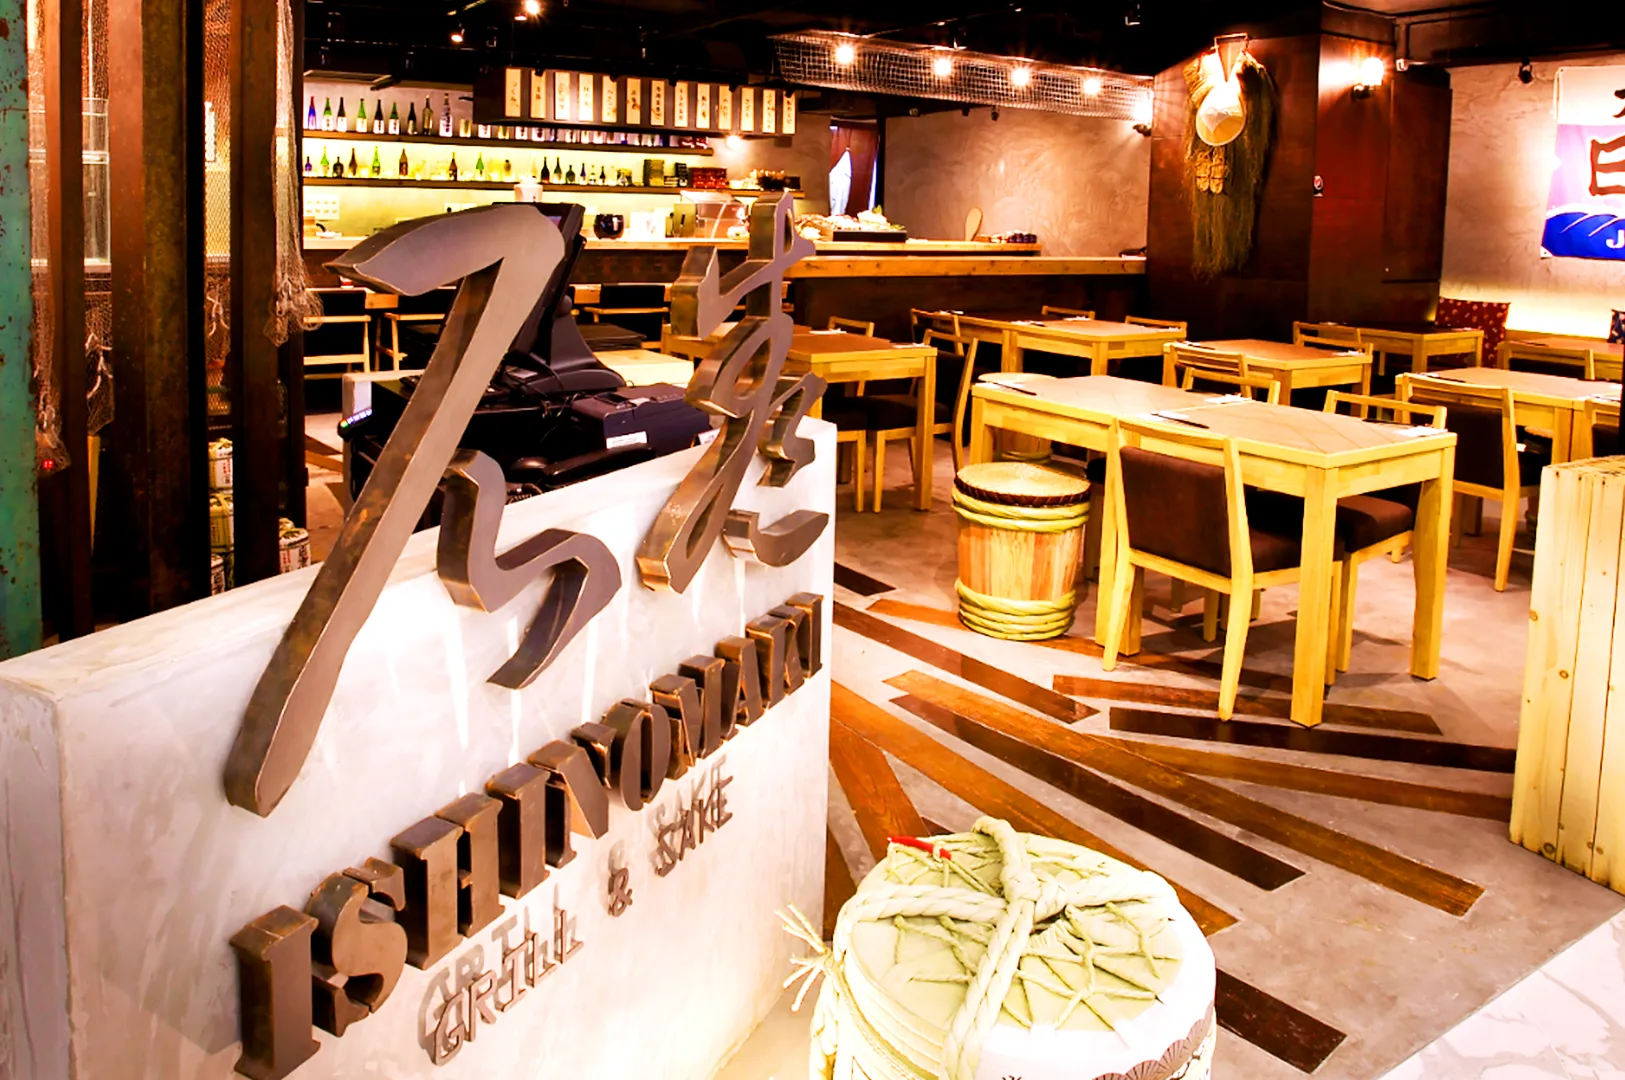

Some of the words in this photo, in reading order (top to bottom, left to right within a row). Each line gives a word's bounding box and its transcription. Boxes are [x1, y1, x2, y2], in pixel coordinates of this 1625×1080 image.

[229, 592, 824, 1080] ISHINOMAKI
[432, 909, 585, 1067] GRILL
[607, 867, 633, 918] &
[655, 774, 734, 878] SAKE
